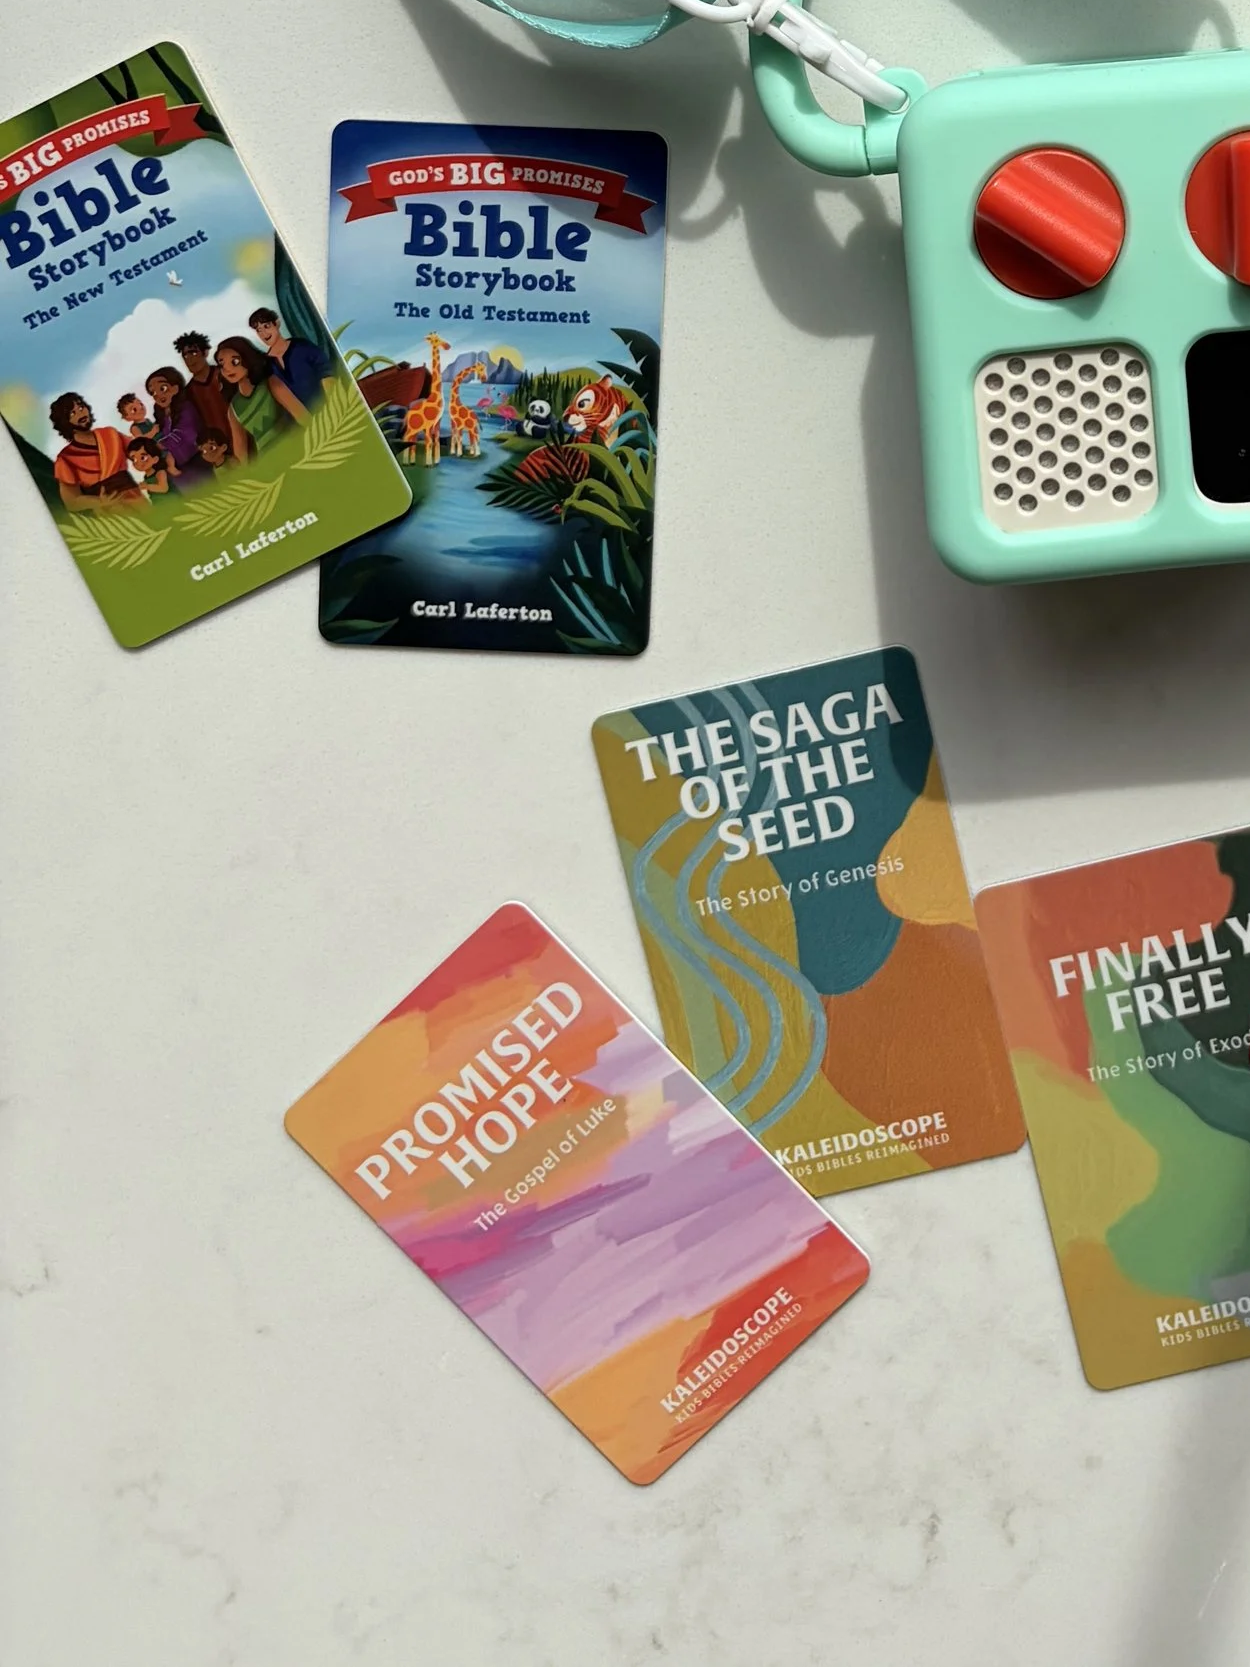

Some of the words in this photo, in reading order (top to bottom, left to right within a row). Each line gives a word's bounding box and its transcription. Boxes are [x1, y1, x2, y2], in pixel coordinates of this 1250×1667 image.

[6, 142, 63, 185] BIG
[62, 109, 151, 152] PROMISES
[389, 166, 444, 186] GOD'S
[449, 162, 506, 186] BIG
[512, 166, 605, 195] PROMISES
[0, 156, 171, 269] Bible
[403, 200, 592, 262] Bible
[23, 306, 60, 330] The
[63, 282, 104, 310] New
[109, 229, 208, 286] Testament
[28, 205, 177, 291] Storybook
[415, 263, 576, 297] Storybook
[393, 301, 430, 319] The
[439, 303, 474, 320] Old
[482, 306, 590, 324] Testament
[190, 550, 234, 581] Carl
[235, 512, 319, 559] Laferton
[412, 599, 457, 619] Carl
[464, 602, 553, 622] Laferton
[624, 719, 740, 782] THE
[749, 683, 904, 755] SAGA
[680, 766, 749, 819] OF
[759, 738, 874, 801] THE
[717, 795, 856, 862] SEED
[696, 896, 732, 917] The
[737, 882, 793, 908] Story
[799, 871, 820, 893] of
[826, 855, 904, 886] Genesis
[1106, 967, 1231, 1032] FREE
[354, 982, 583, 1201] PROMISED
[1087, 1065, 1121, 1082] The
[1127, 1051, 1177, 1074] Story
[1182, 1040, 1202, 1061] of
[438, 1058, 574, 1189] HOPE
[775, 1112, 947, 1166] KALEIDOSCOPE
[817, 1153, 862, 1173] BIBLES
[866, 1133, 950, 1161] REIMAGINED
[473, 1203, 508, 1232] The
[504, 1149, 560, 1205] Gospel
[559, 1130, 579, 1154] of
[576, 1097, 617, 1137] Luke
[660, 1286, 793, 1413] KALEIDOSCOPE
[674, 1398, 702, 1424] KIDS
[701, 1363, 739, 1400] BIBLES
[737, 1303, 802, 1365] REIMAGINED
[1161, 1331, 1192, 1347] KIDS
[1196, 1320, 1240, 1339] BIBLES
